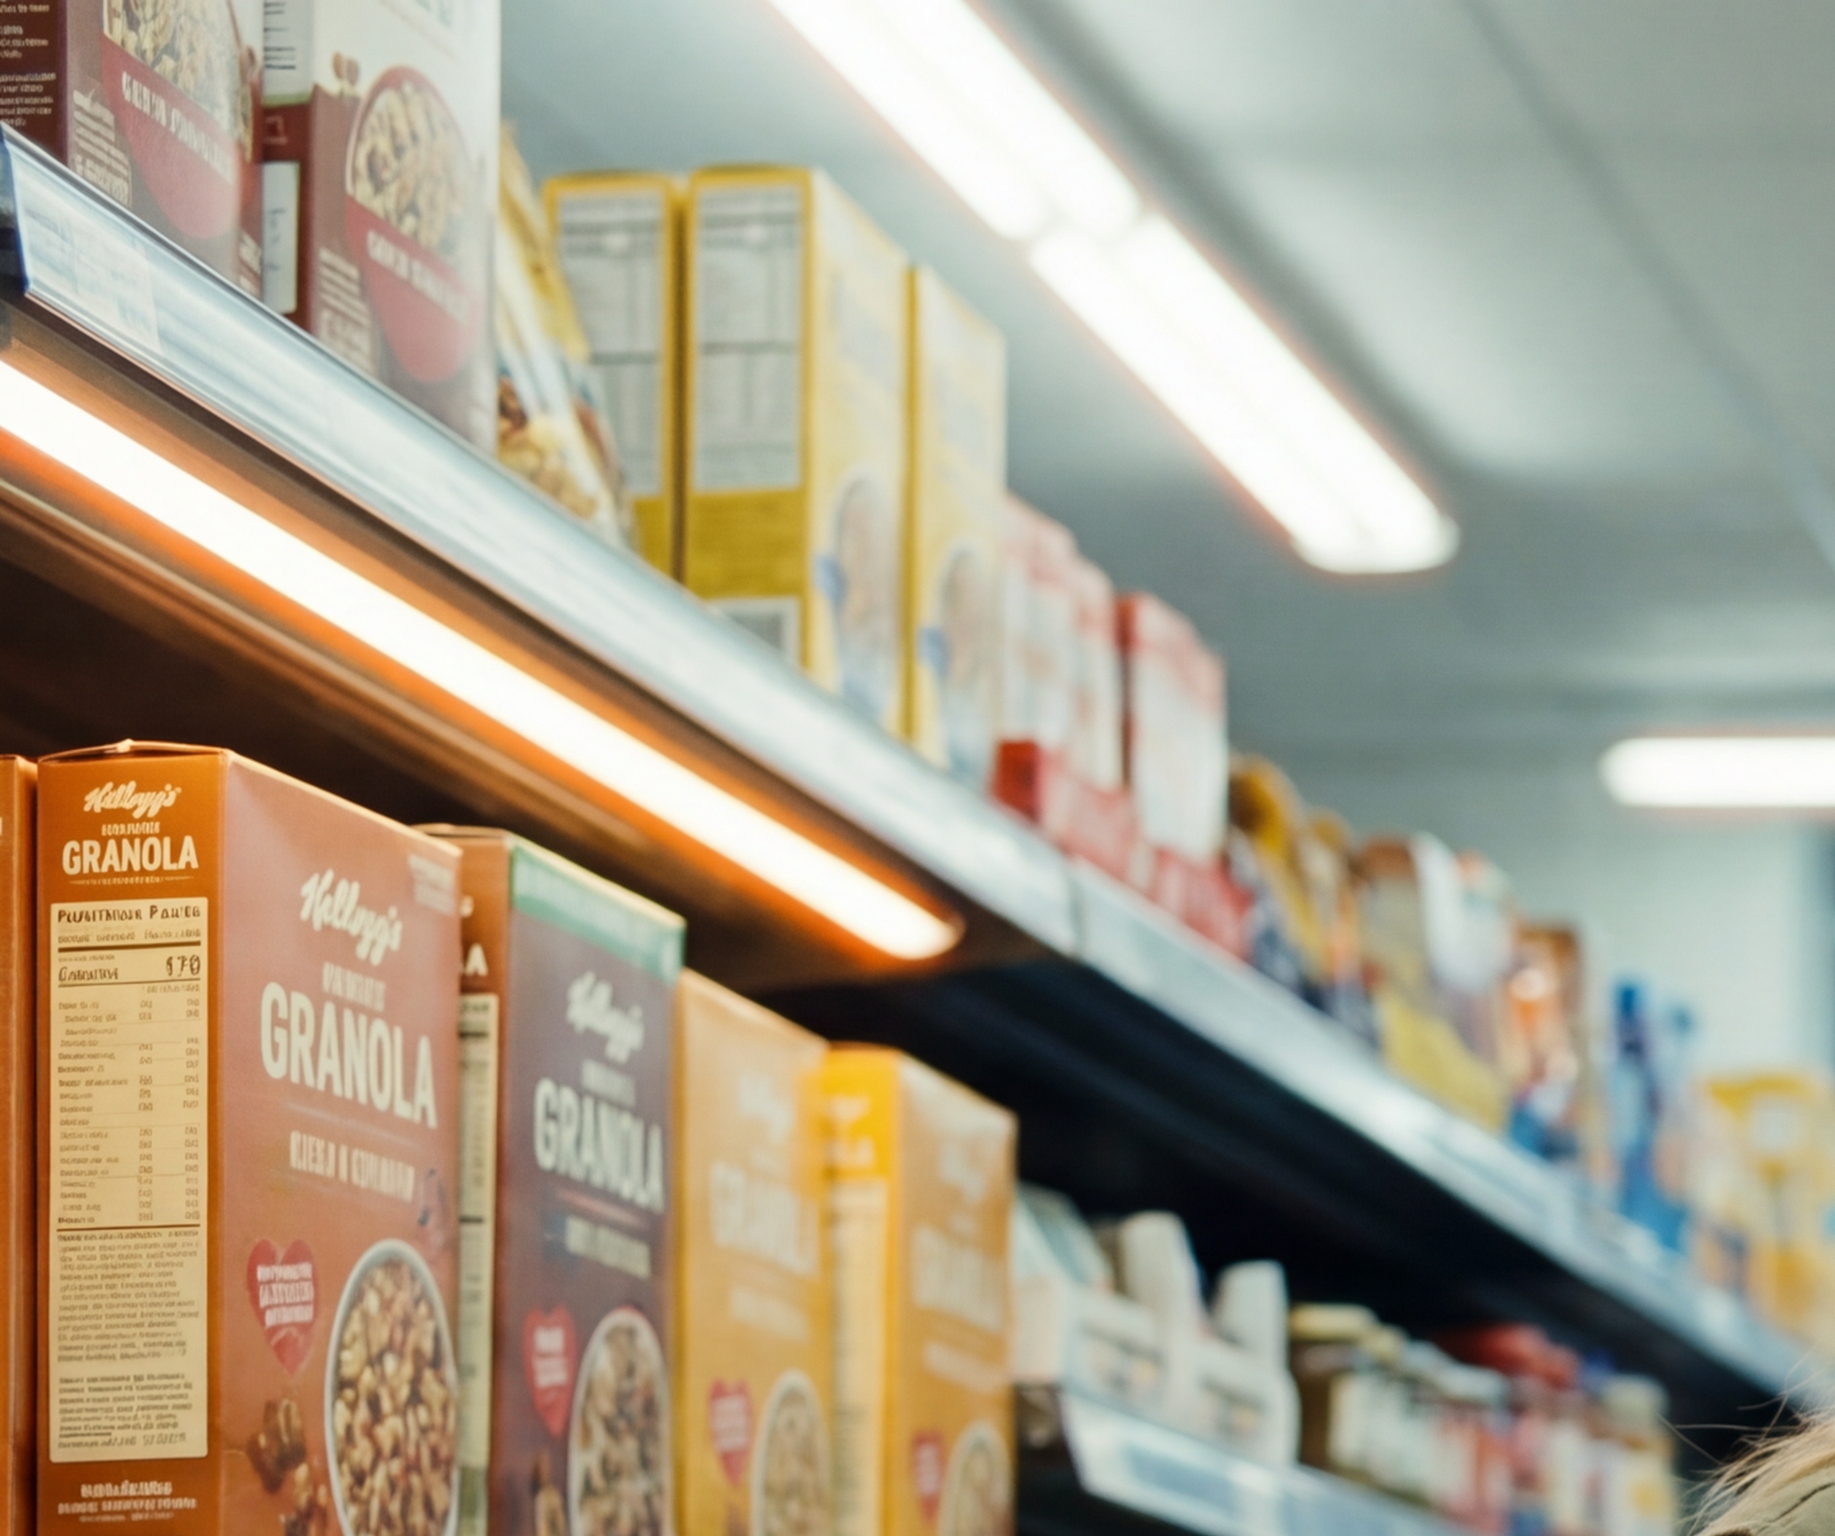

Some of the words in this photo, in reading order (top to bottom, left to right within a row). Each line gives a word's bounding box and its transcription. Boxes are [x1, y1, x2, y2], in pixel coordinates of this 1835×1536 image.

[62, 835, 199, 876] GRANOLA
[260, 981, 438, 1130] GRANOLA
[533, 1078, 667, 1213] GRANOLA
